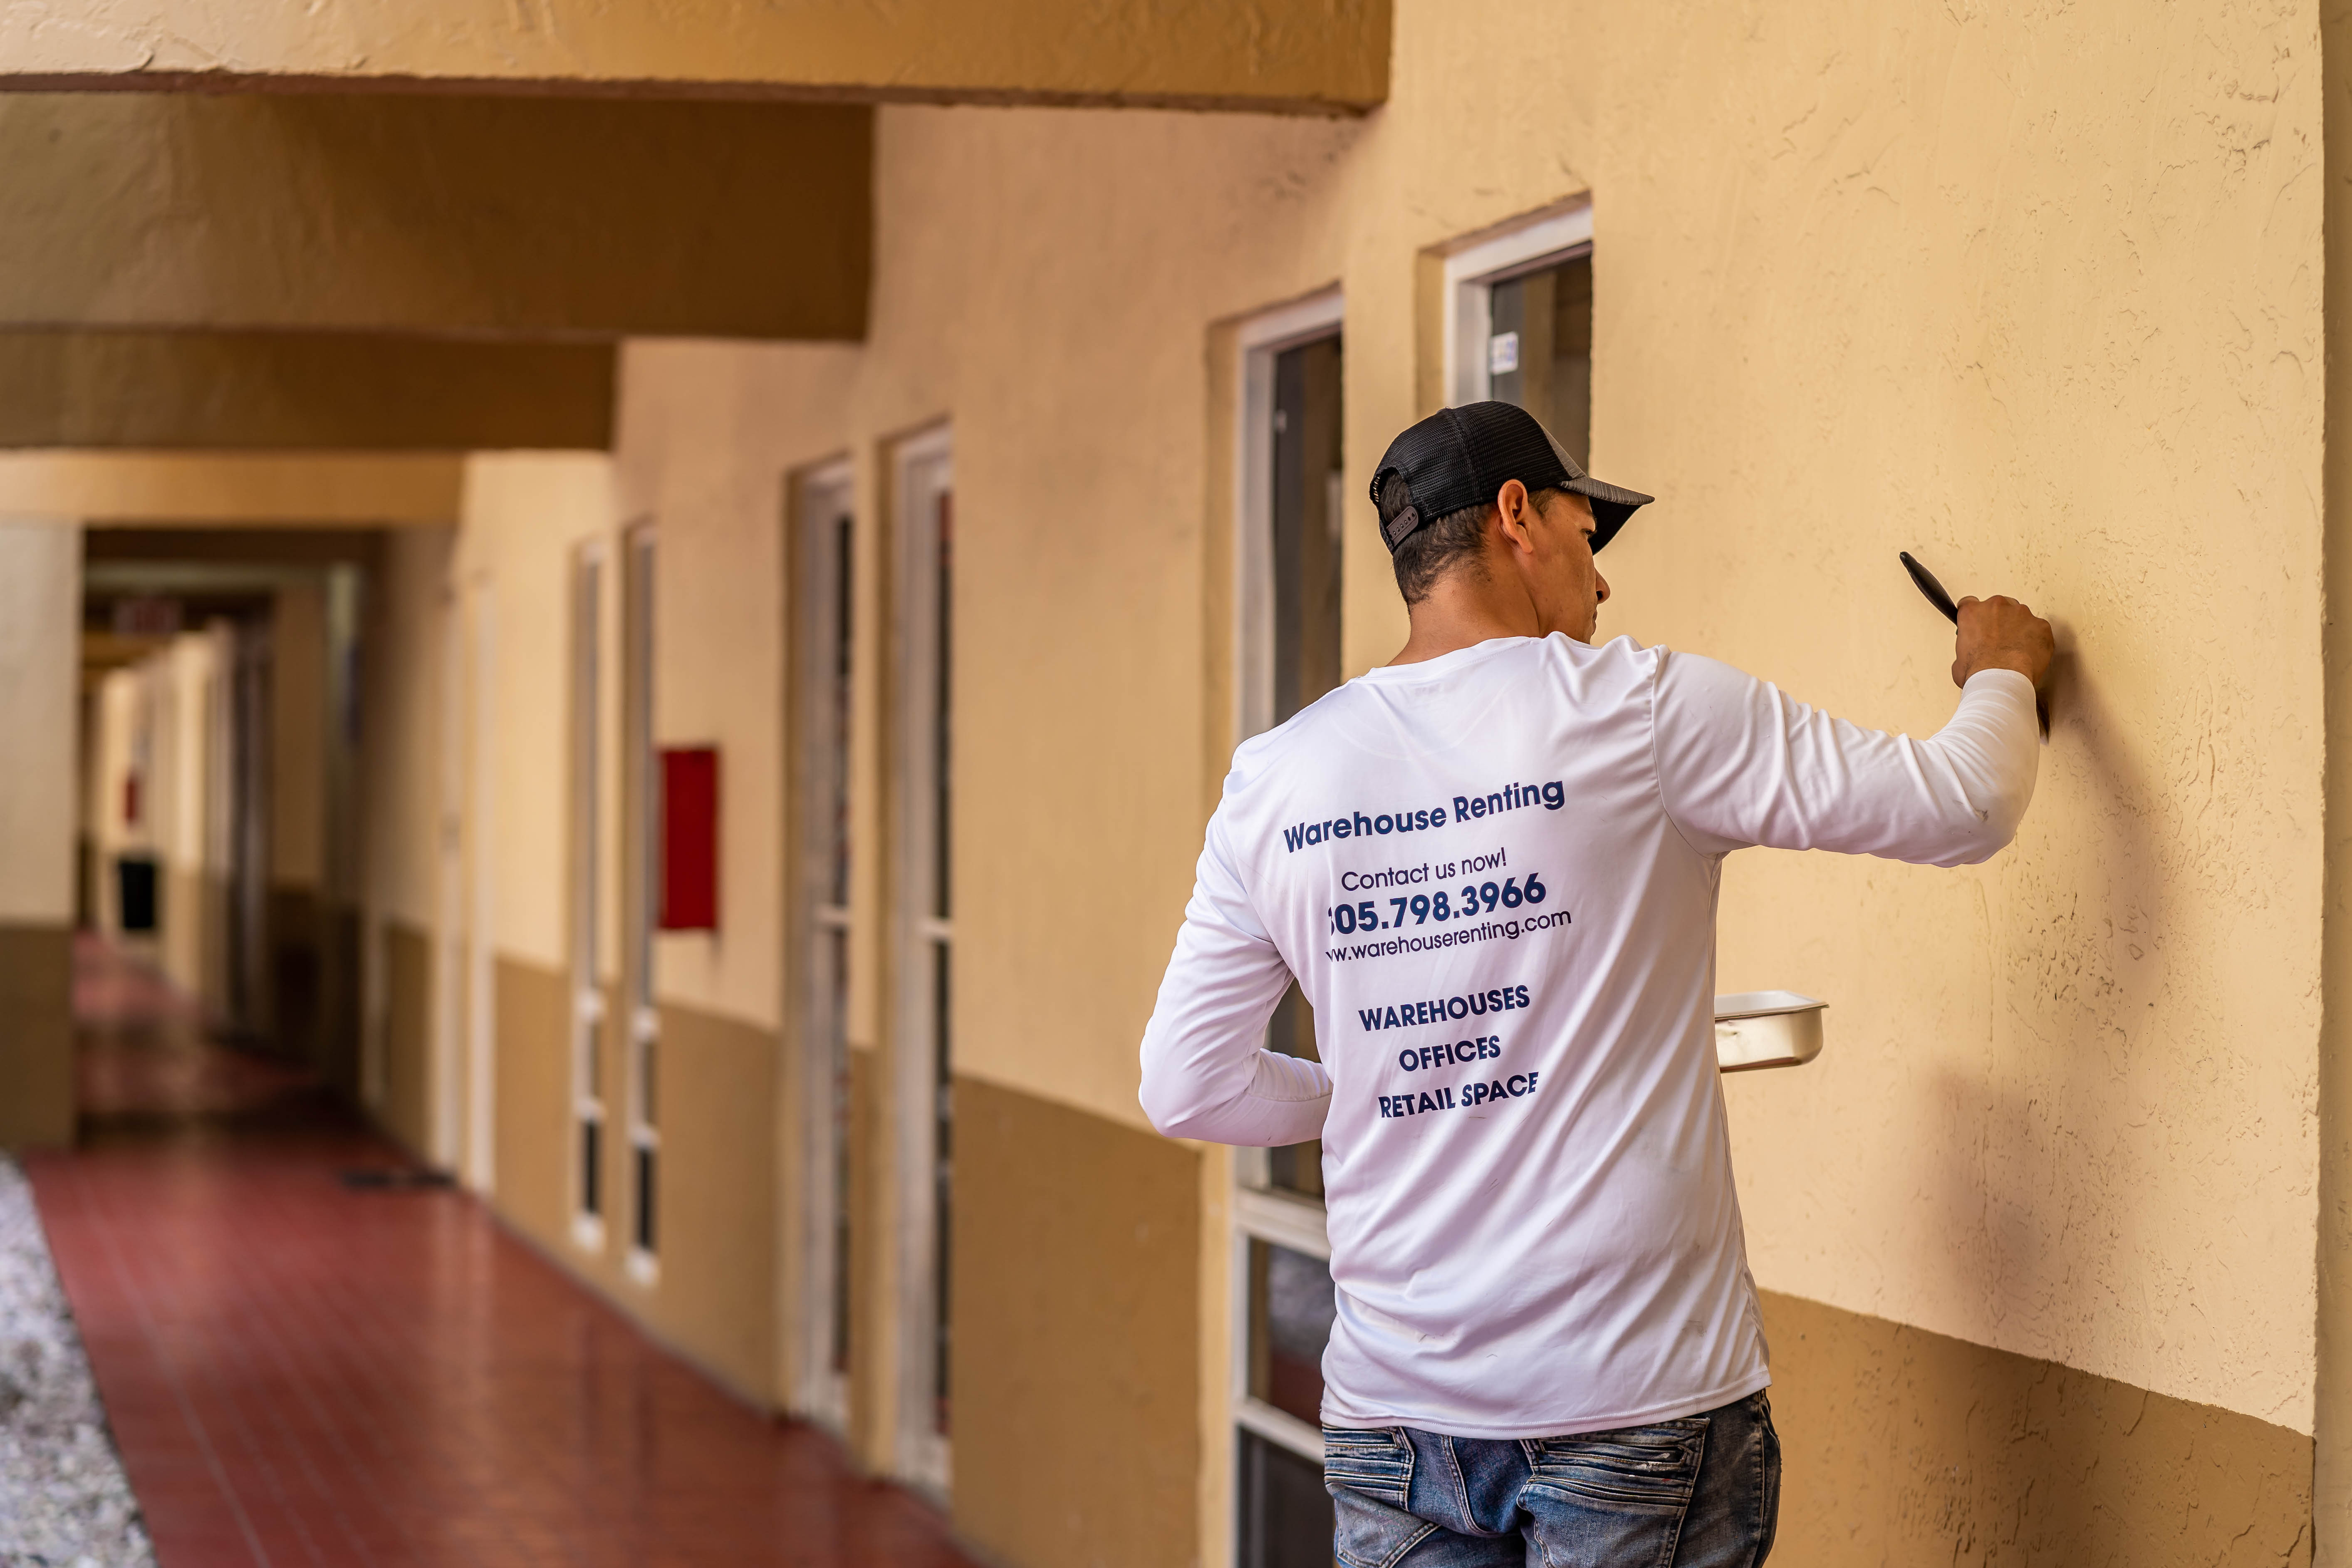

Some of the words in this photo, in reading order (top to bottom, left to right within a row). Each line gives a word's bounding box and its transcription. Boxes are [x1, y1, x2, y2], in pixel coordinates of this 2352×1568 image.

[1283, 808, 1447, 853] Warehouse
[1453, 780, 1565, 823] Renting
[1341, 862, 1429, 891] Contact
[1436, 862, 1456, 879] us
[1461, 847, 1507, 875] now!
[1358, 985, 1530, 1031] WAREHOUSES
[1399, 1035, 1501, 1072] OFFICES
[1378, 1087, 1456, 1118] RETAIL
[1461, 1071, 1539, 1107] SPACE
